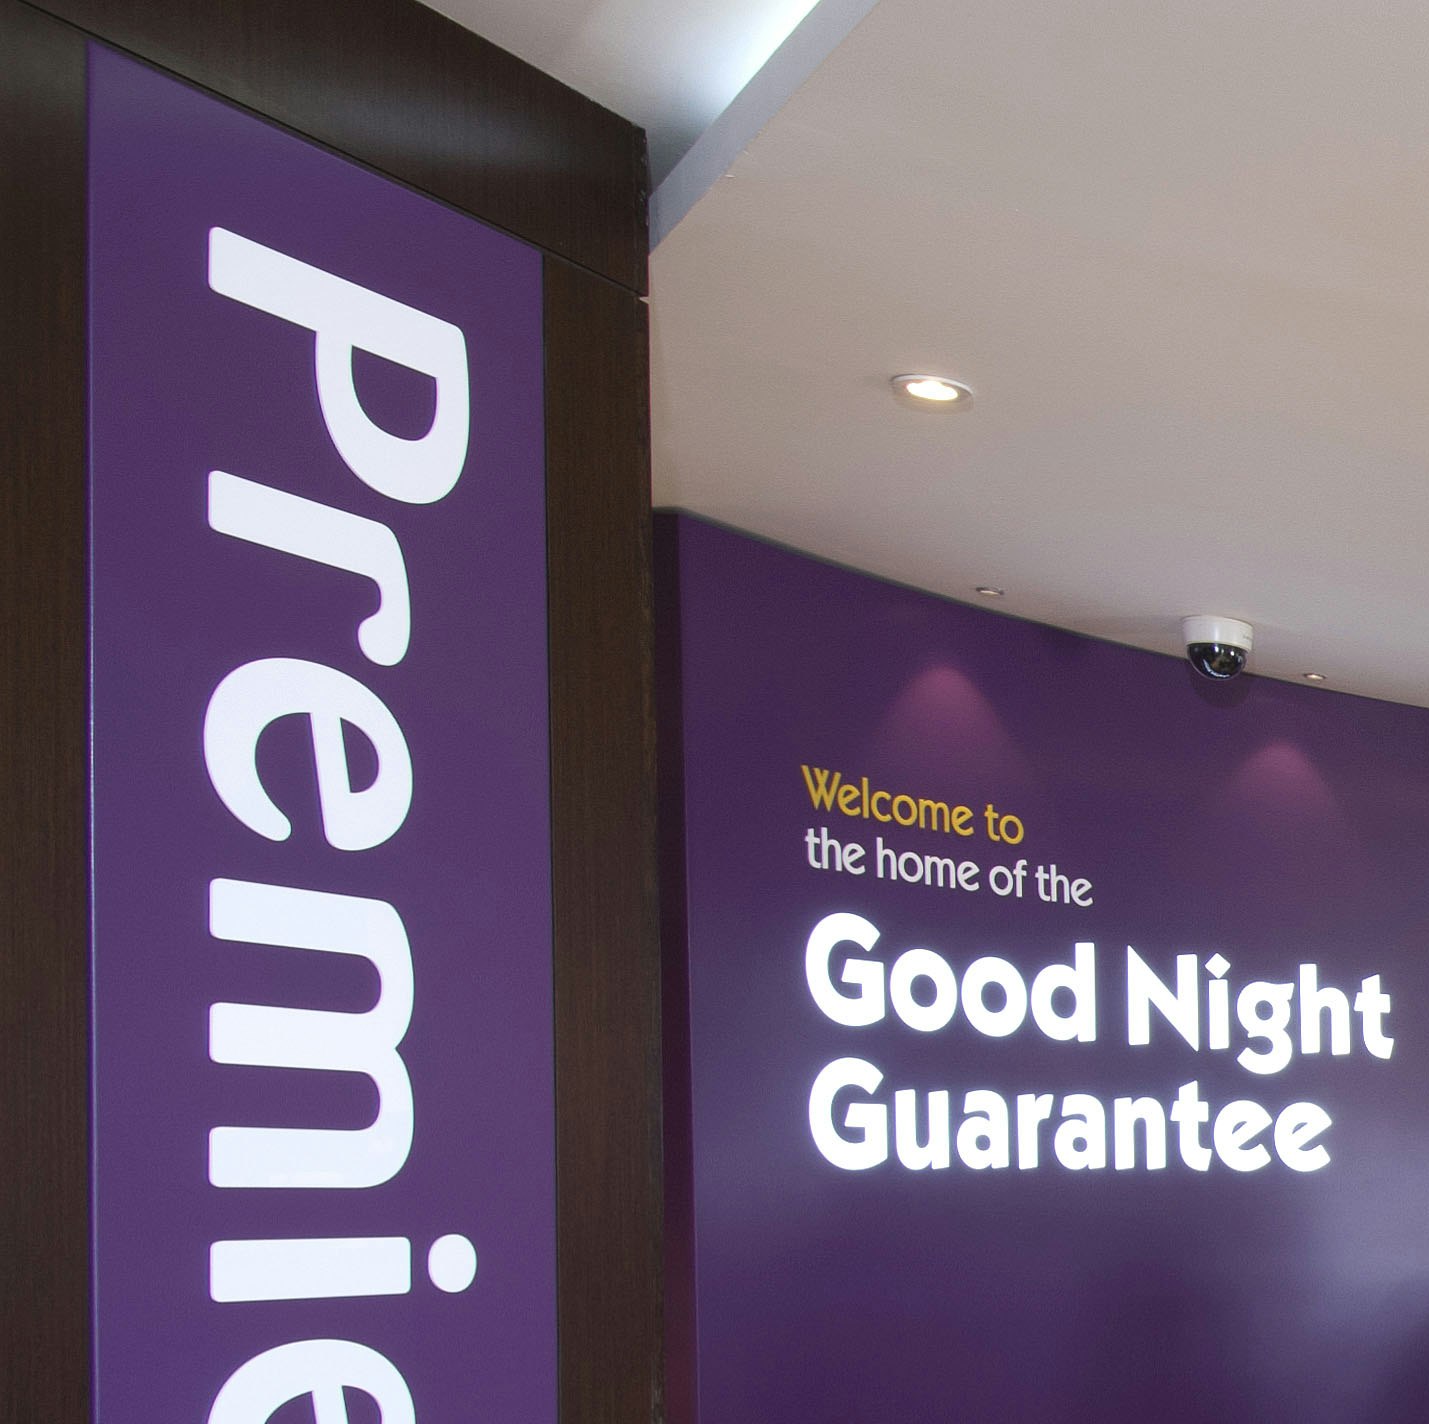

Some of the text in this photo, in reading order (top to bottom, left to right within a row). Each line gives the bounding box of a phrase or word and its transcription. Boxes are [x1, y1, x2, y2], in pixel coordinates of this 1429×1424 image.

[801, 764, 1024, 845] Welcome to
[804, 826, 1093, 907] the home of the
[805, 911, 1395, 1076] Good Night
[808, 1056, 1333, 1173] Guarantee
